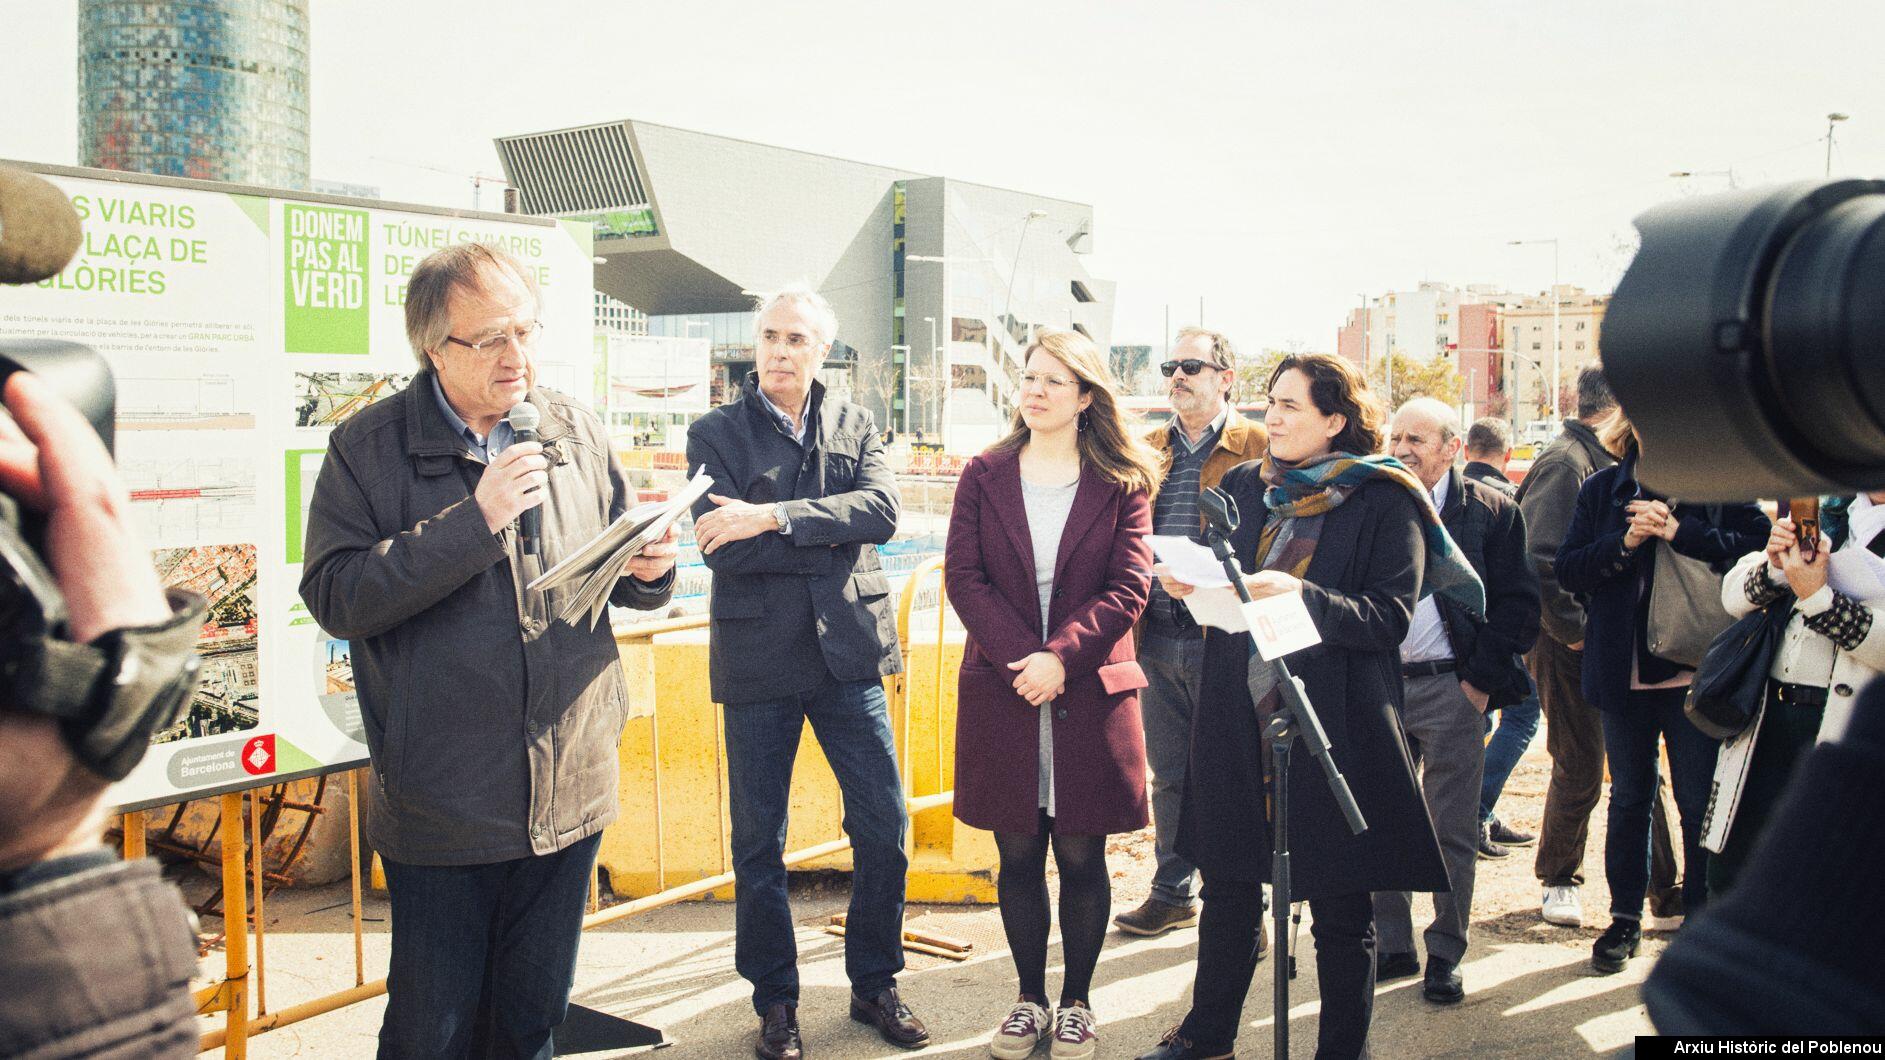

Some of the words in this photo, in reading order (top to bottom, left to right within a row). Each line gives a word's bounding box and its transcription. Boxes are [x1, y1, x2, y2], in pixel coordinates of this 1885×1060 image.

[98, 197, 195, 229] VIARIS
[291, 208, 363, 242] DONEM
[170, 238, 207, 263] DE
[291, 239, 331, 270] PAS
[337, 243, 363, 273] AL
[385, 254, 414, 276] DE
[291, 269, 363, 310] VERD
[181, 752, 224, 766] Ajuntament
[225, 750, 235, 758] de
[181, 760, 236, 777] Barcelona
